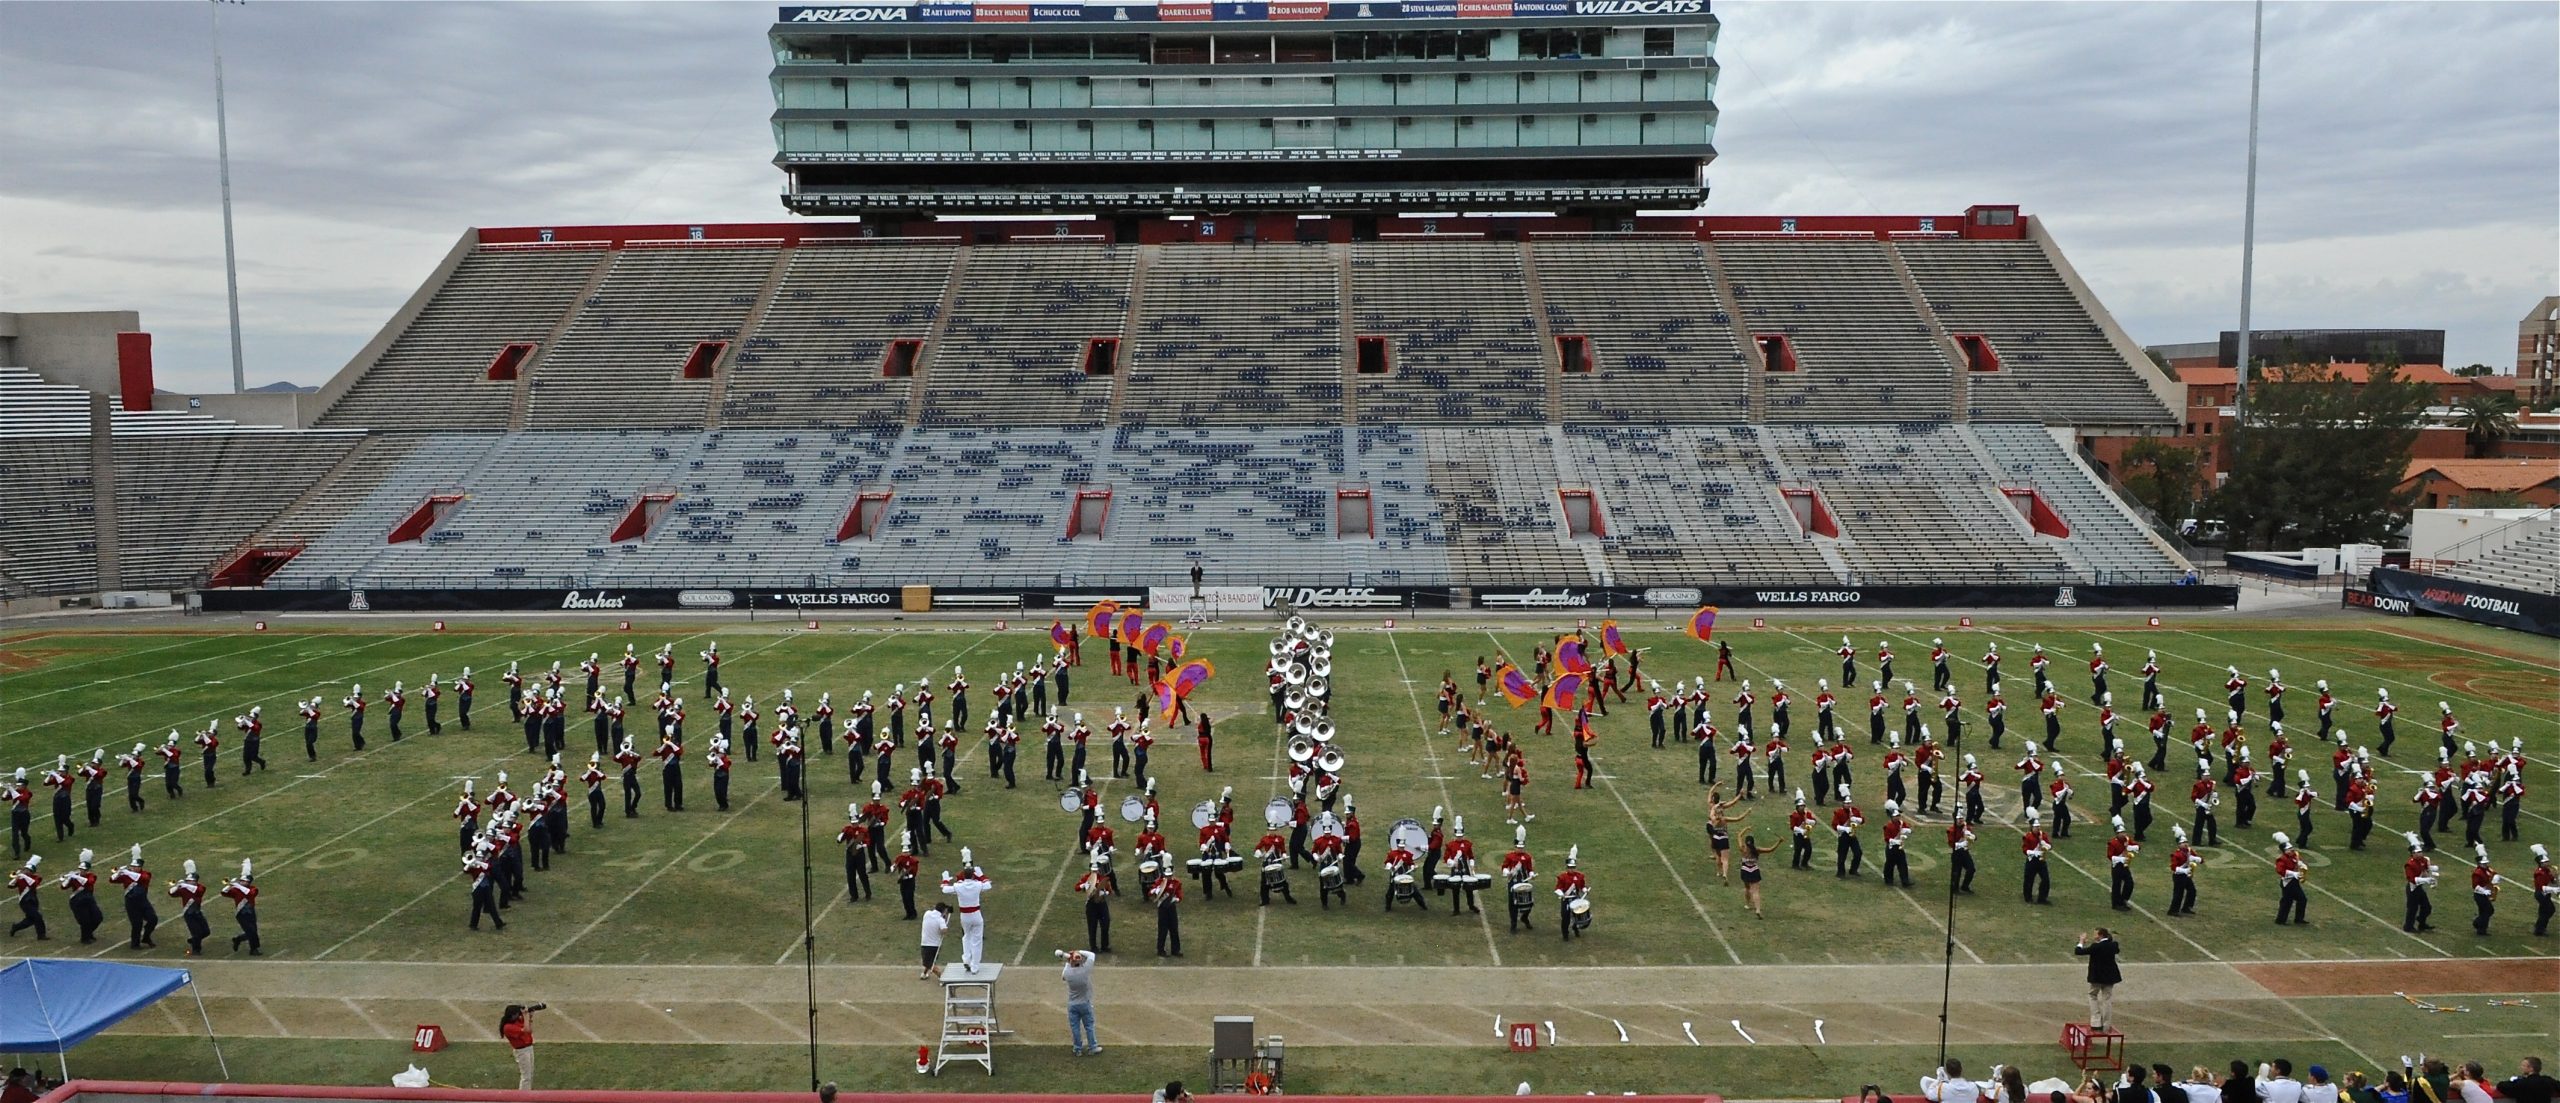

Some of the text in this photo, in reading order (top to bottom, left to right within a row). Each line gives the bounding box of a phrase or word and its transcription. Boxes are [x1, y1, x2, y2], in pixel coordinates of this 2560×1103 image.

[1575, 1, 1702, 13] WILDCATS
[792, 8, 907, 21] ARIZONA
[1193, 8, 1211, 16] LEWIS
[1203, 226, 1214, 235] 21
[1424, 225, 1436, 233] 22
[1621, 223, 1633, 232] 23
[1782, 223, 1795, 231] 24
[1921, 223, 1932, 231] 25
[691, 232, 701, 240] 18
[862, 230, 872, 238] 19
[1056, 228, 1068, 236] 20
[542, 233, 552, 243] 17
[191, 399, 200, 407] 16
[561, 591, 625, 608] Bashas'
[787, 594, 889, 603] WELLS FARGO
[1153, 594, 1185, 603] UNIVERSITY
[1228, 593, 1245, 602] BAND
[1247, 593, 1260, 602] DAY
[1756, 592, 1860, 602] WELLS FARGO
[2464, 594, 2519, 615] FOOTBALL
[416, 1028, 434, 1048] 40
[1514, 1028, 1532, 1047] 40
